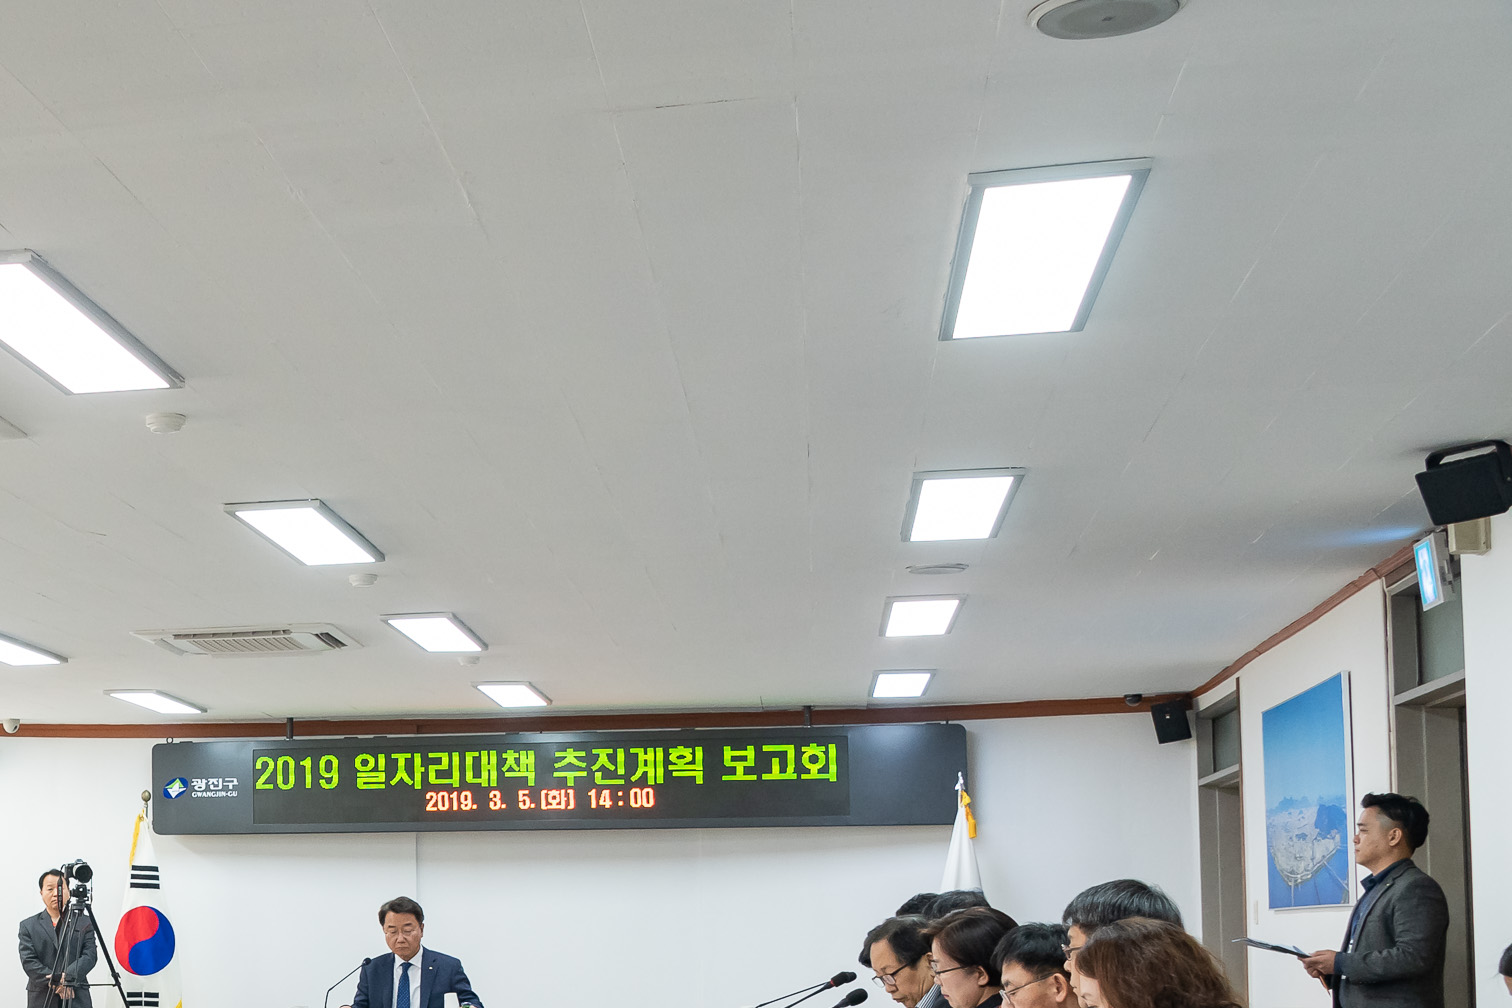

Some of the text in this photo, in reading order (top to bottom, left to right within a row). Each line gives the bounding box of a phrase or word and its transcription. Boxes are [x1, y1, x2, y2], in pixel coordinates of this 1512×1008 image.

[255, 742, 837, 791] 2019 일자리대책 추진계획 보고회
[190, 777, 239, 791] 광진구
[191, 790, 238, 798] GWANGJIN-GU
[425, 790, 478, 812] 2019.
[488, 790, 507, 811] 3.
